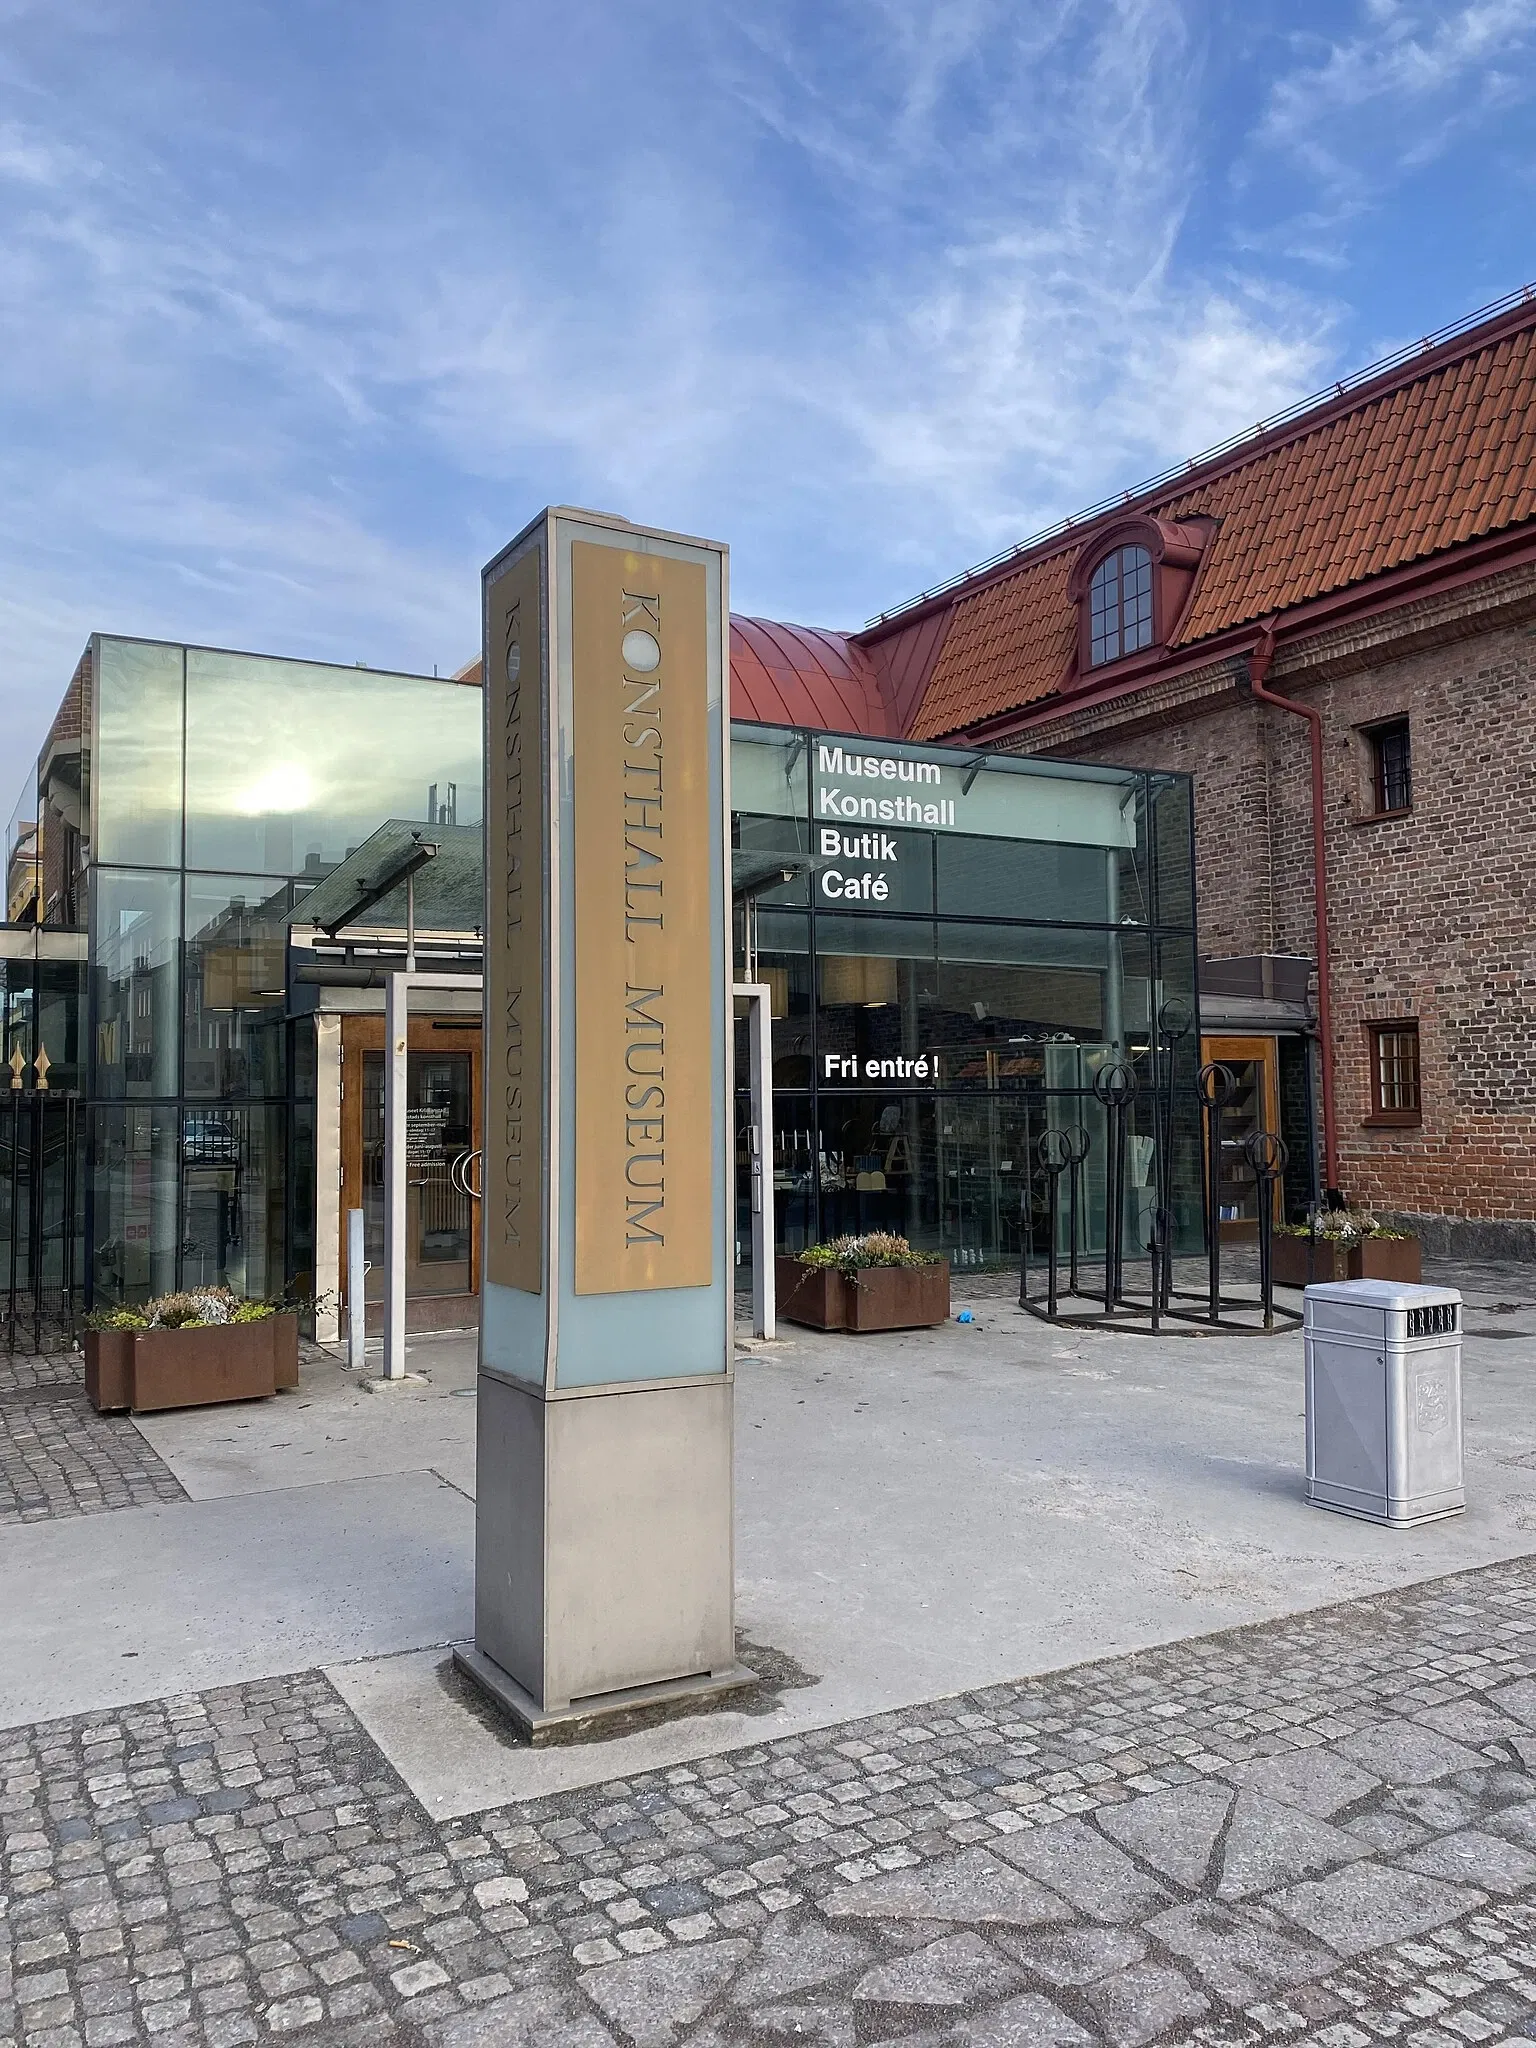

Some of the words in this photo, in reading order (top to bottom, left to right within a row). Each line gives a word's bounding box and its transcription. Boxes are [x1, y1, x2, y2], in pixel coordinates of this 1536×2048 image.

[505, 598, 522, 949] KONSTHALL
[622, 588, 663, 943] KONSTHALL
[819, 745, 941, 784] Museum
[820, 787, 955, 826] Konsthall
[820, 828, 898, 861] Butik
[821, 870, 889, 901] Café
[825, 1054, 858, 1078] Fri
[504, 986, 522, 1248] MUSEUM
[625, 982, 665, 1248] MUSEUM
